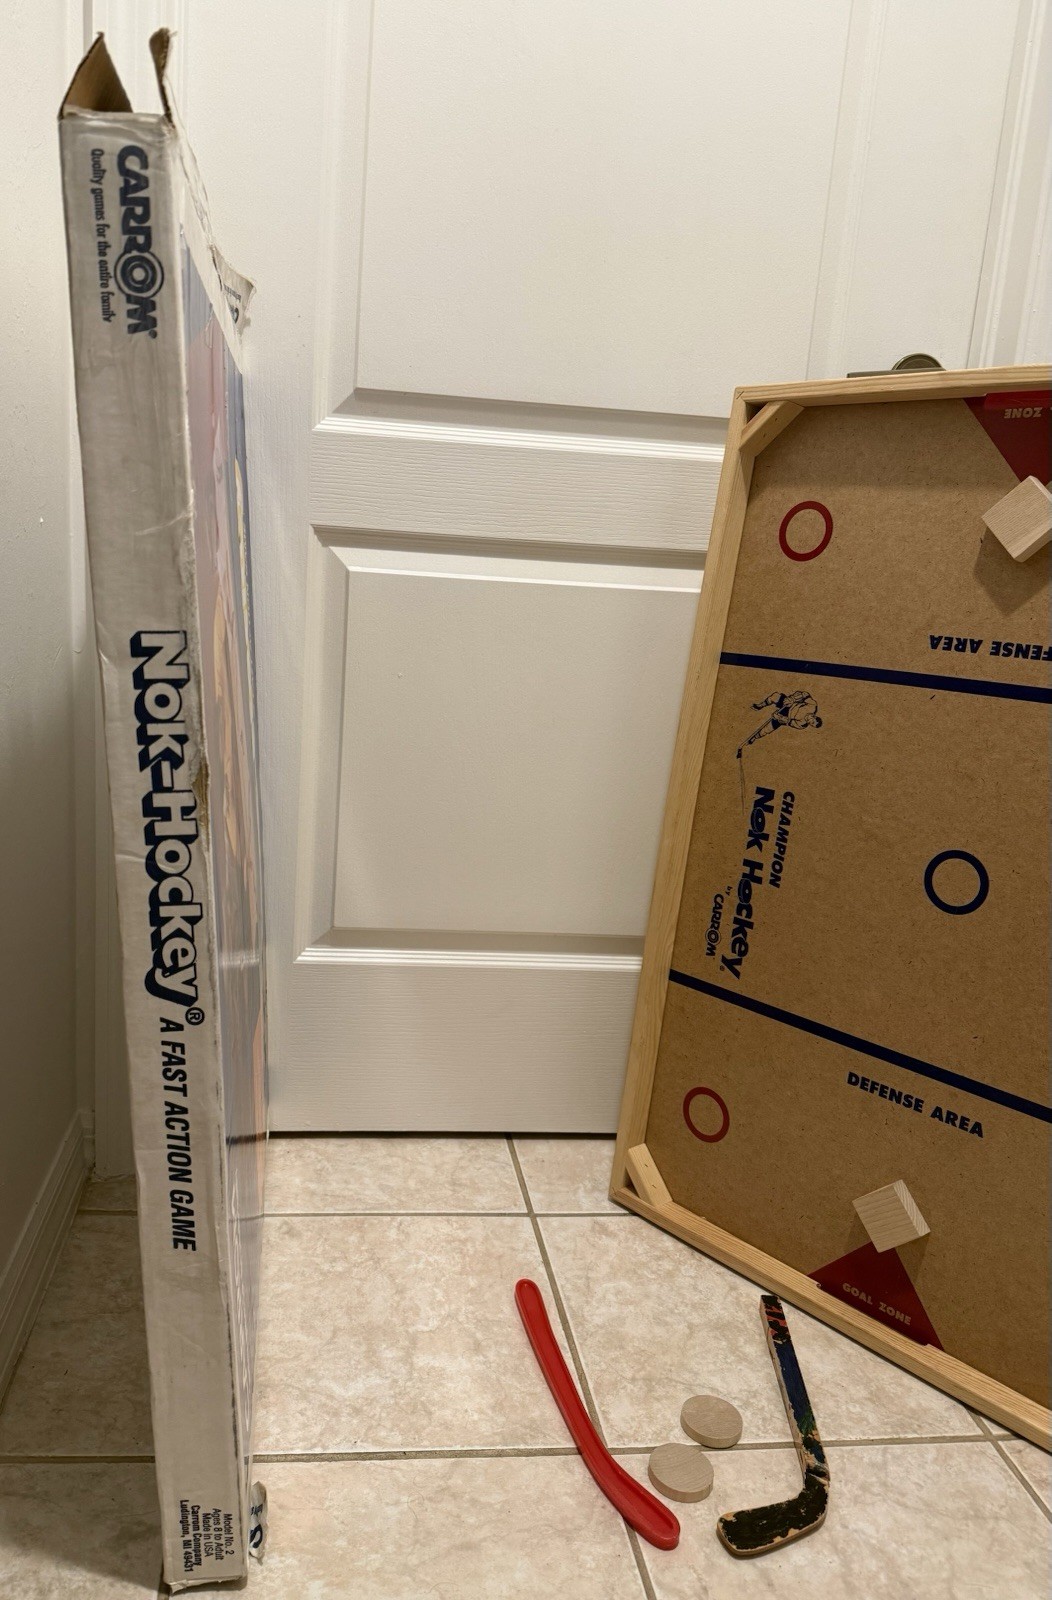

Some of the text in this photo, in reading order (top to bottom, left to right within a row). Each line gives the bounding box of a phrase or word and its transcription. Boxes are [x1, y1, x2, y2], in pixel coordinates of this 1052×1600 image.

[90, 149, 117, 323] Quality games for the entire family
[114, 145, 165, 334] CARROM
[1003, 407, 1043, 419] ZONE
[928, 634, 983, 653] AREA
[769, 791, 795, 888] CHAMPION
[720, 786, 776, 980] Nok Hockey
[725, 885, 733, 897] by
[705, 893, 725, 957] CARROM
[847, 1071, 985, 1139] DEFENSE AREA
[159, 1016, 197, 1252] A FAST ACTION GAME
[842, 1282, 912, 1327] GOAL ZONE
[202, 1513, 212, 1532] Made
[211, 1508, 221, 1526] Ages
[223, 1513, 233, 1535] Model
[179, 1500, 194, 1572] Ludington, MI 49431
[191, 1504, 203, 1566] Carrom Company
[204, 1541, 214, 1558] USA
[214, 1533, 223, 1541] to
[214, 1541, 225, 1561] Adult
[224, 1536, 234, 1549] No.
